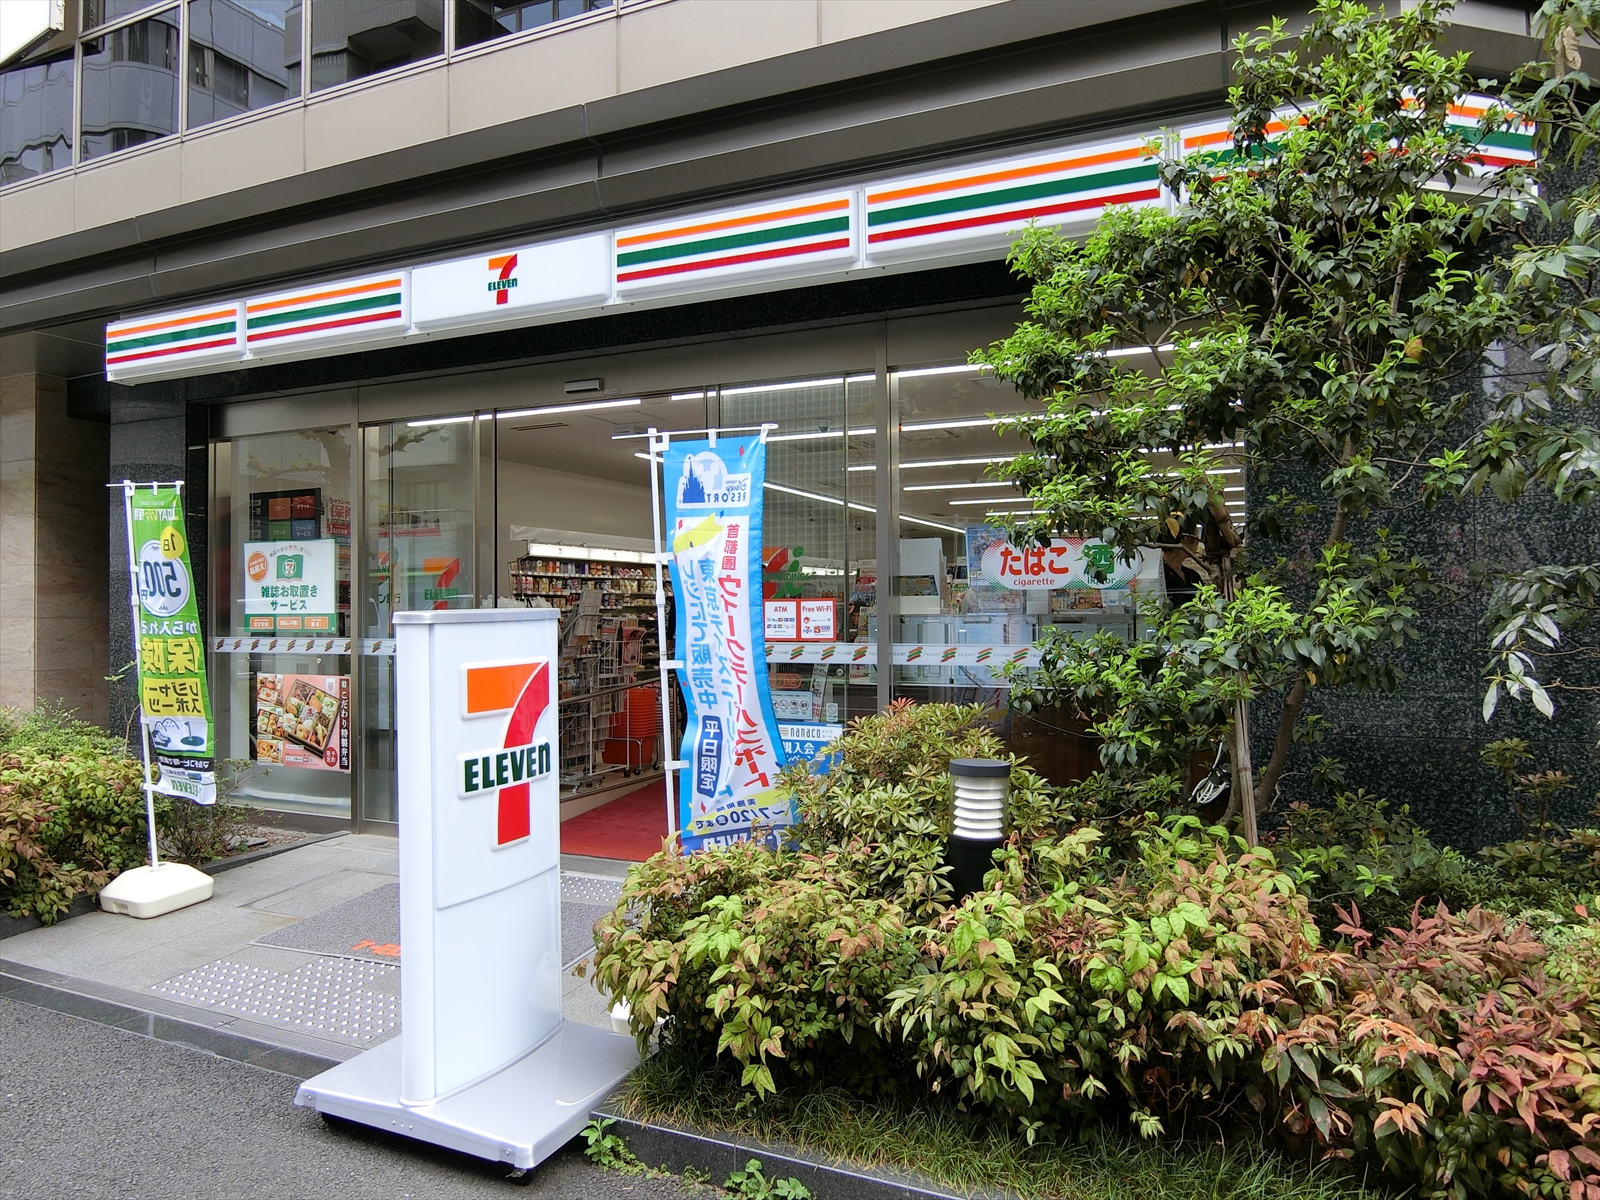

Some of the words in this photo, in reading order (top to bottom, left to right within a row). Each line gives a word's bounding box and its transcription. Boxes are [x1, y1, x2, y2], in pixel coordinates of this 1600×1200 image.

[488, 253, 518, 305] 7
[1000, 546, 1069, 576] たばこ
[1084, 544, 1115, 575] 酒
[261, 585, 318, 598] 雑誌お取置き
[1014, 578, 1055, 586] cigarette
[270, 600, 307, 610] サービス
[790, 728, 820, 738] nanaco
[467, 660, 550, 846] 7
